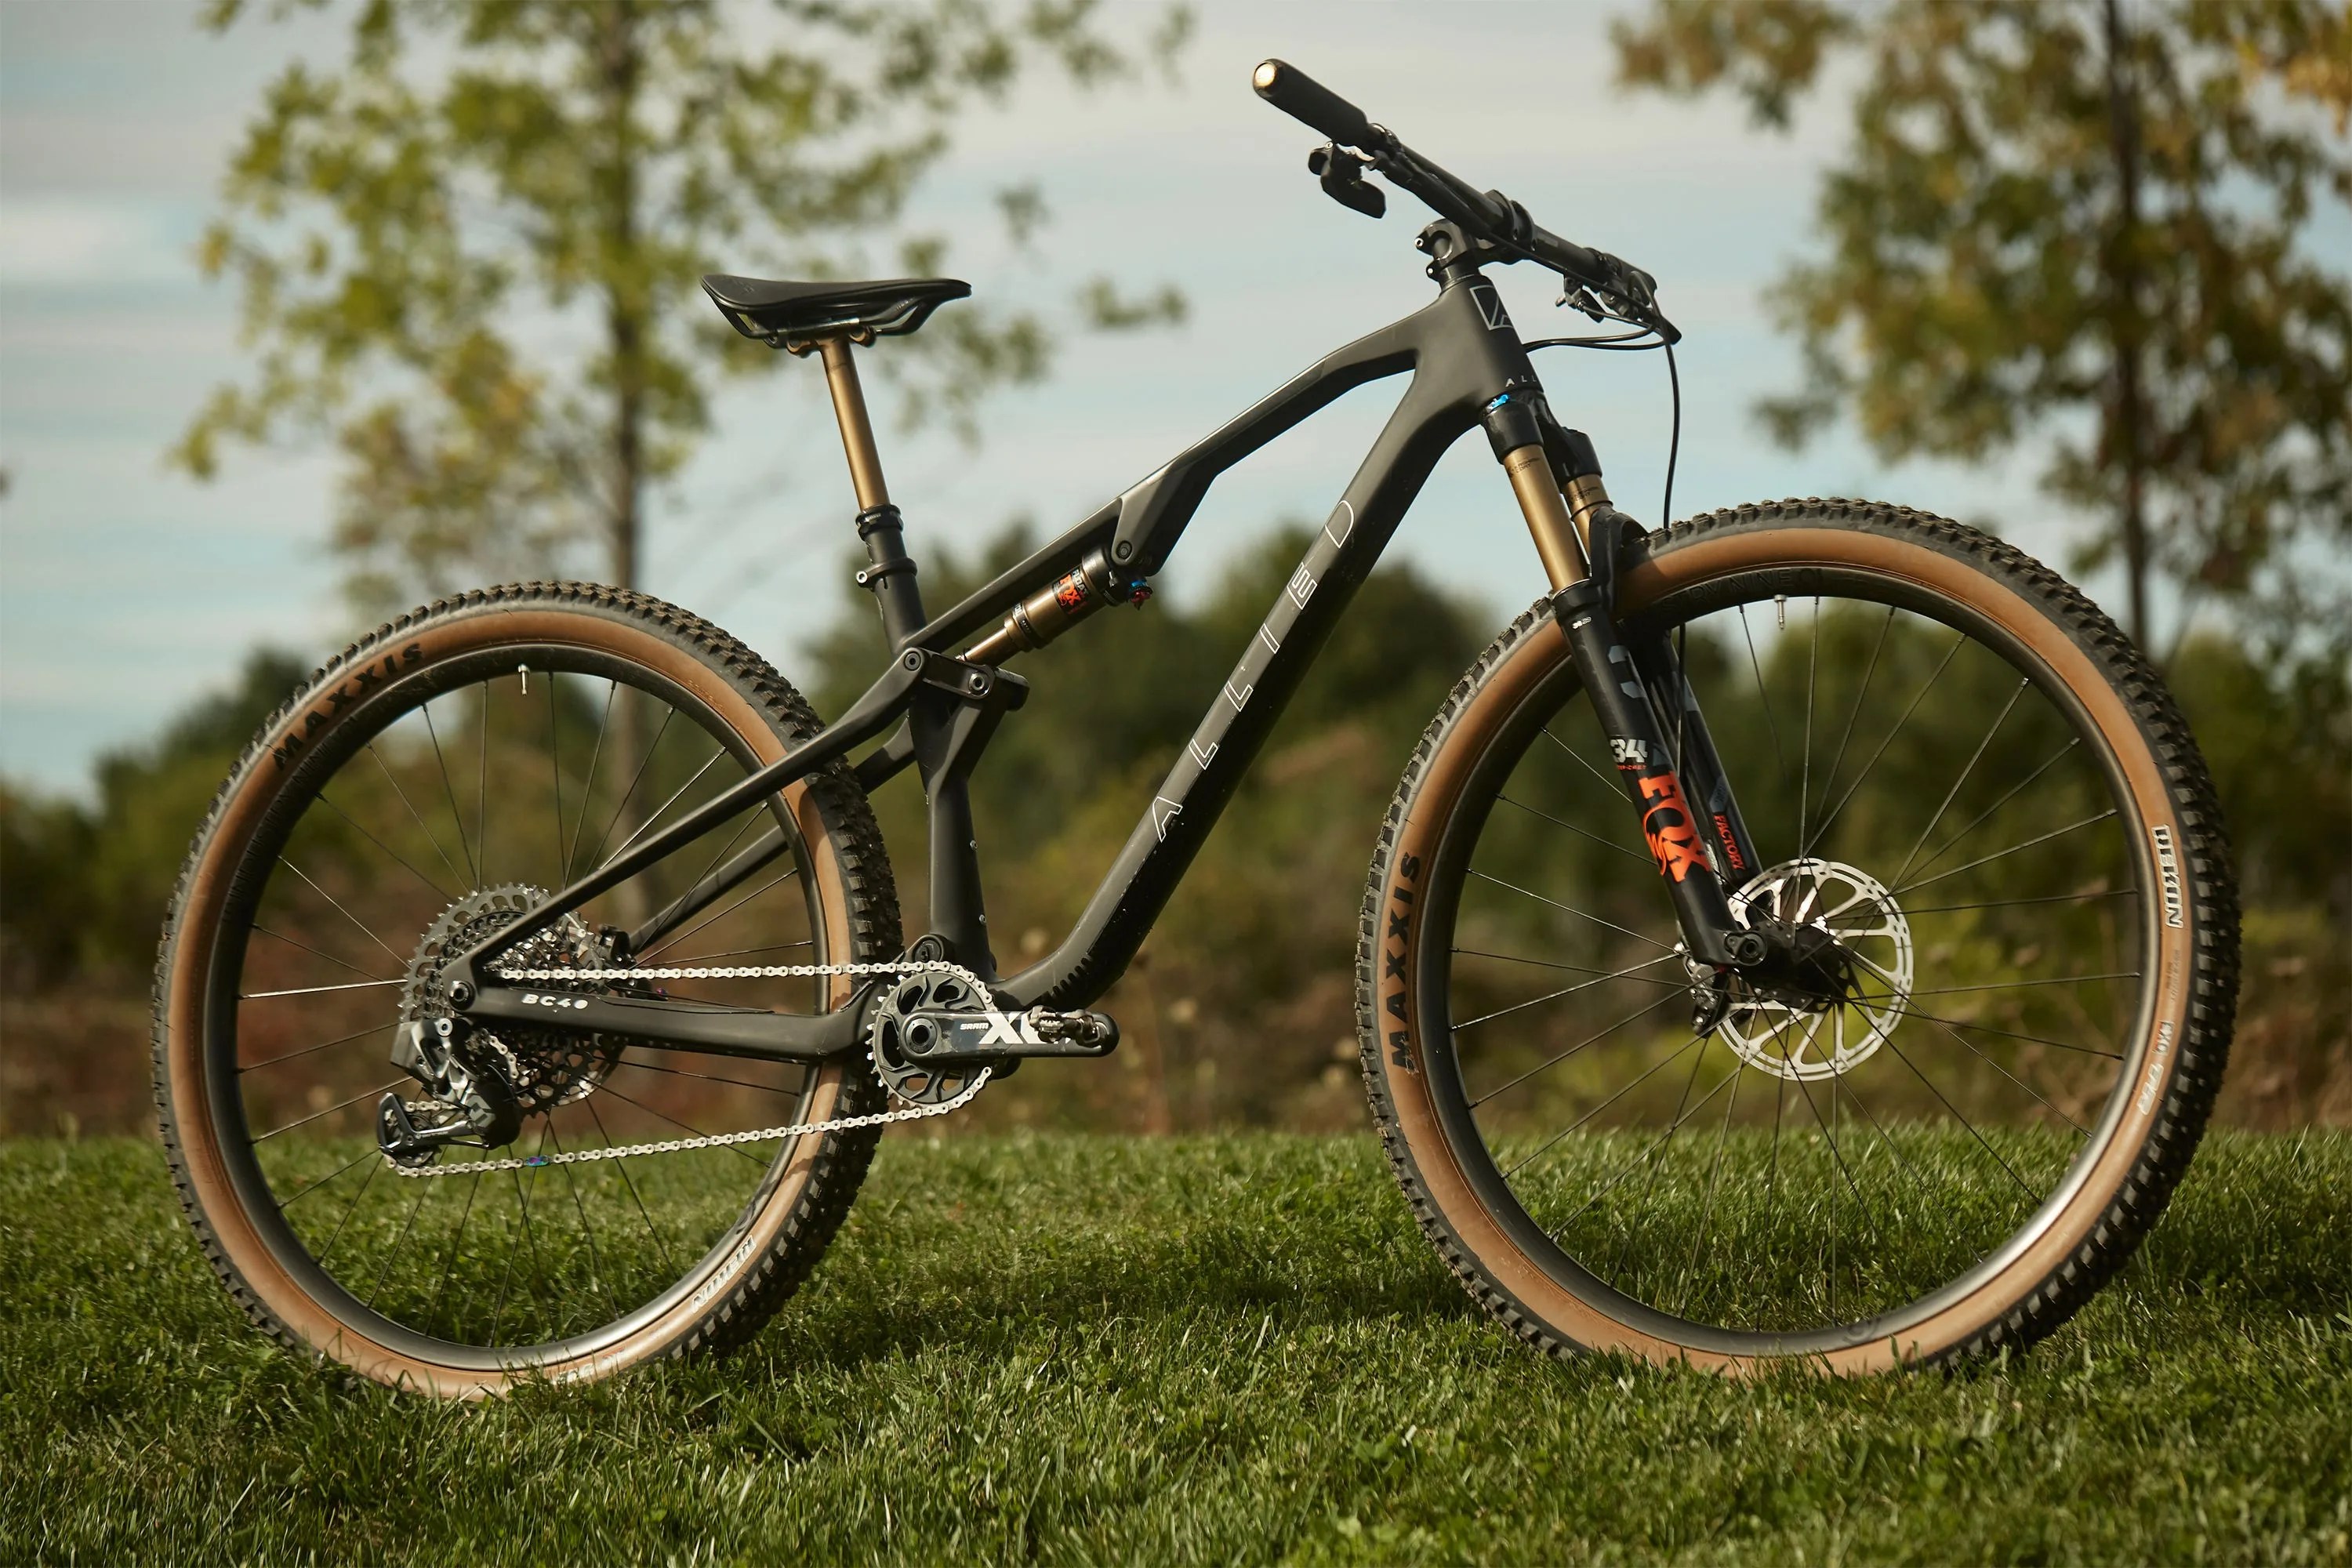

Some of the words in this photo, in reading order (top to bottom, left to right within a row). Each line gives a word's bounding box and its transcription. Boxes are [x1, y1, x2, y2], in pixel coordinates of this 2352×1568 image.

[1504, 374, 1537, 388] ALL
[271, 643, 424, 771] MAXXIS
[1151, 499, 1355, 843] ALLIED
[1610, 739, 1648, 763] 34
[1638, 770, 1712, 883] FOX
[1713, 815, 1746, 869] FACTORY
[1385, 851, 1420, 1069] MAXXIS
[960, 1022, 989, 1031] SRAM
